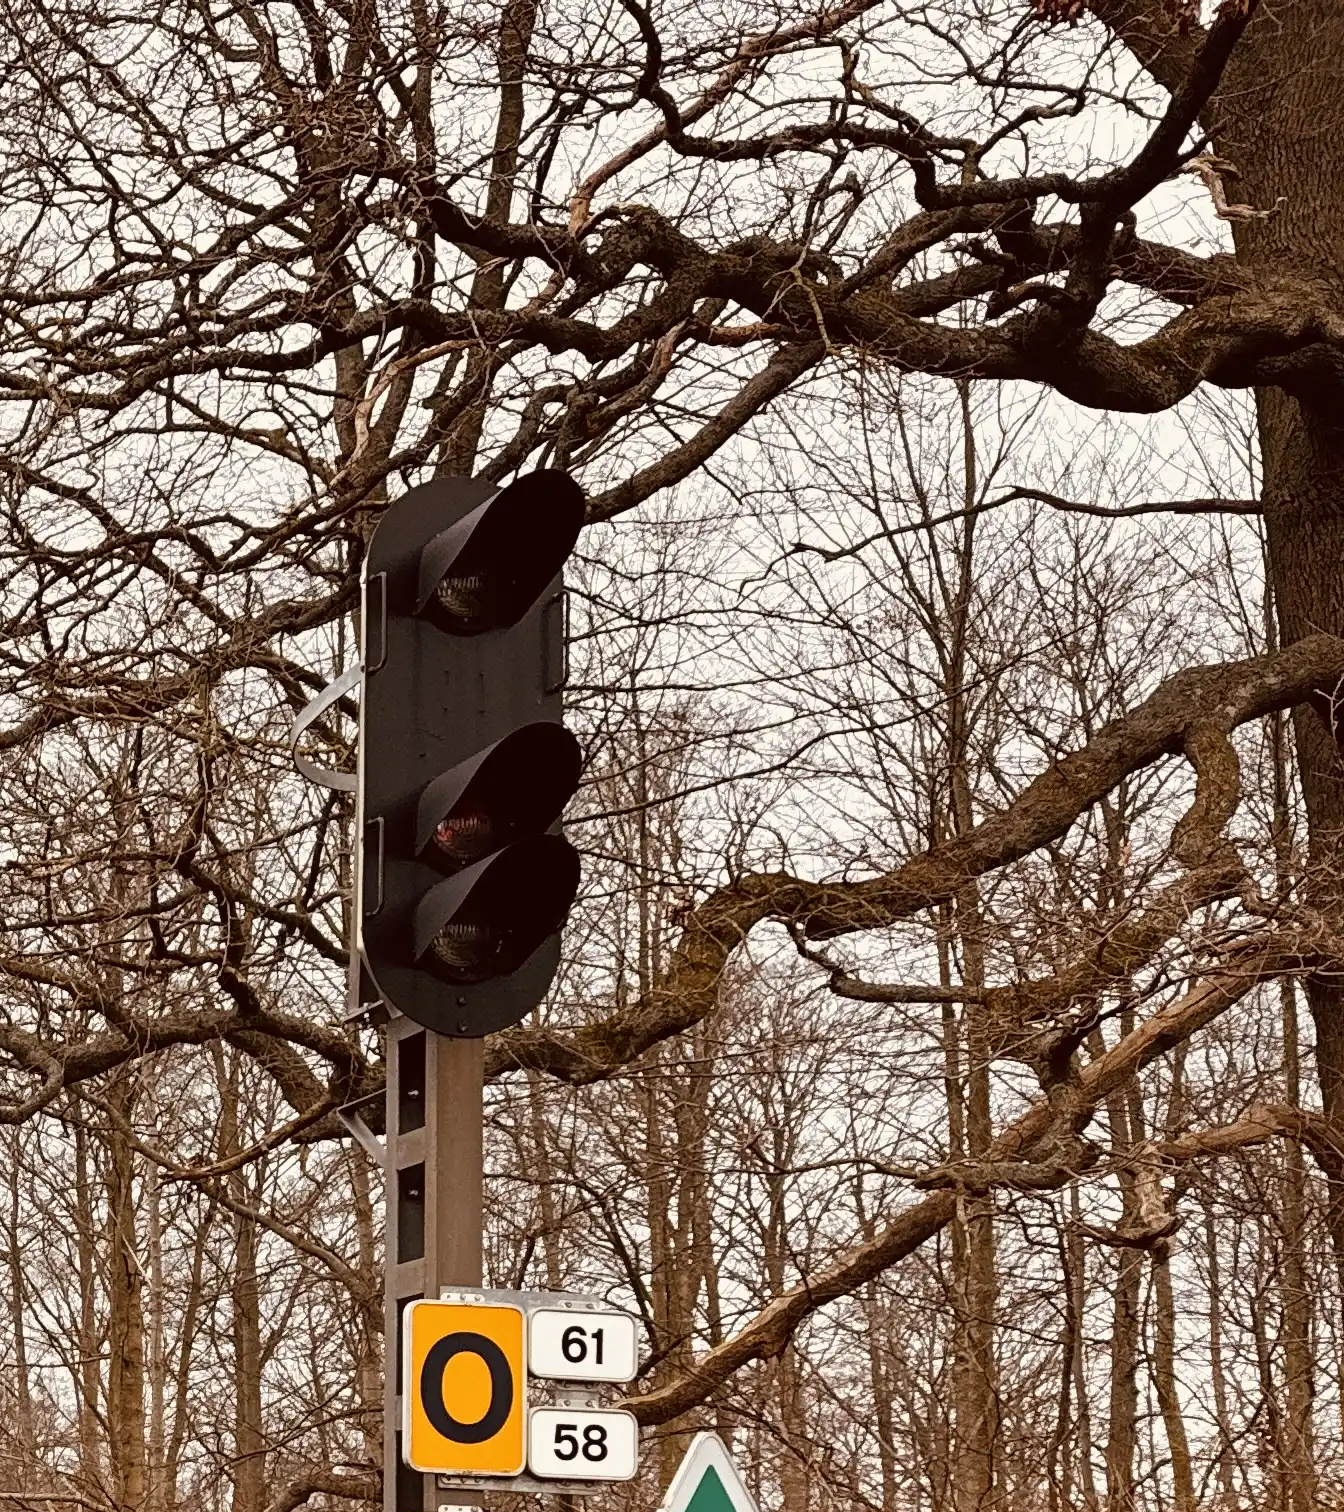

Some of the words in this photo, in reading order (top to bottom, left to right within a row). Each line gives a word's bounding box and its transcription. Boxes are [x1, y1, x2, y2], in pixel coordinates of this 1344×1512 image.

[561, 1325, 604, 1365] 61
[420, 1331, 514, 1444] O
[553, 1423, 609, 1462] 58
